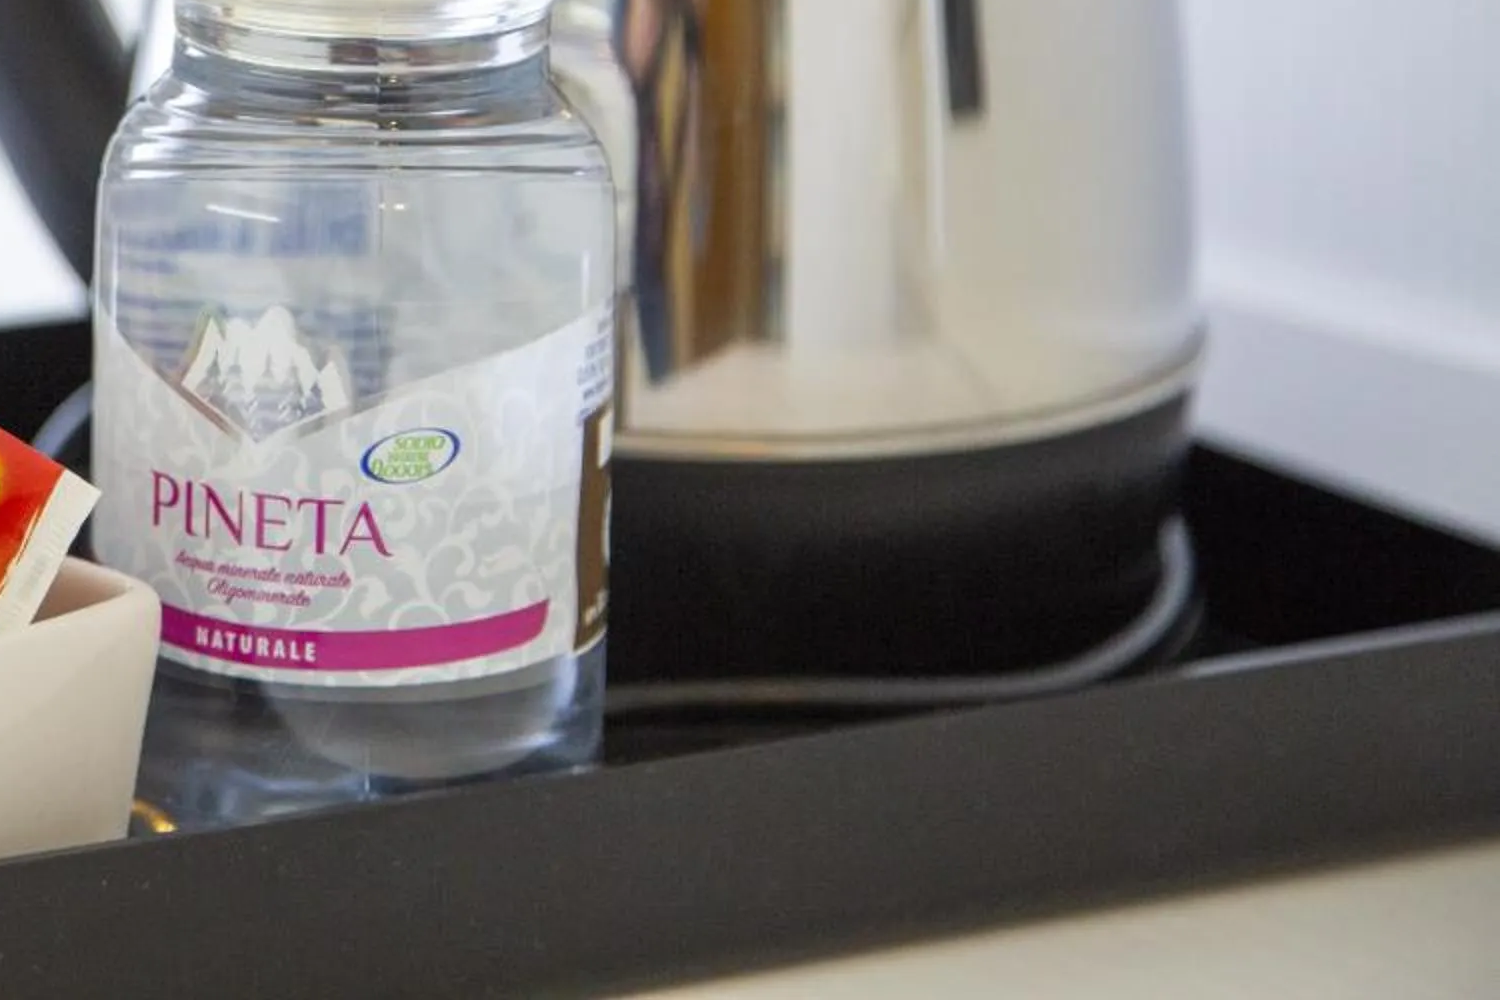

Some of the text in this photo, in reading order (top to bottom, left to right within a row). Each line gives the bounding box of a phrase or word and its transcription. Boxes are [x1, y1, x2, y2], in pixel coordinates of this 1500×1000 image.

[151, 469, 394, 558] PINETA
[216, 563, 282, 584] minerale
[283, 570, 352, 588] naturale
[195, 625, 317, 663] NATURALE
